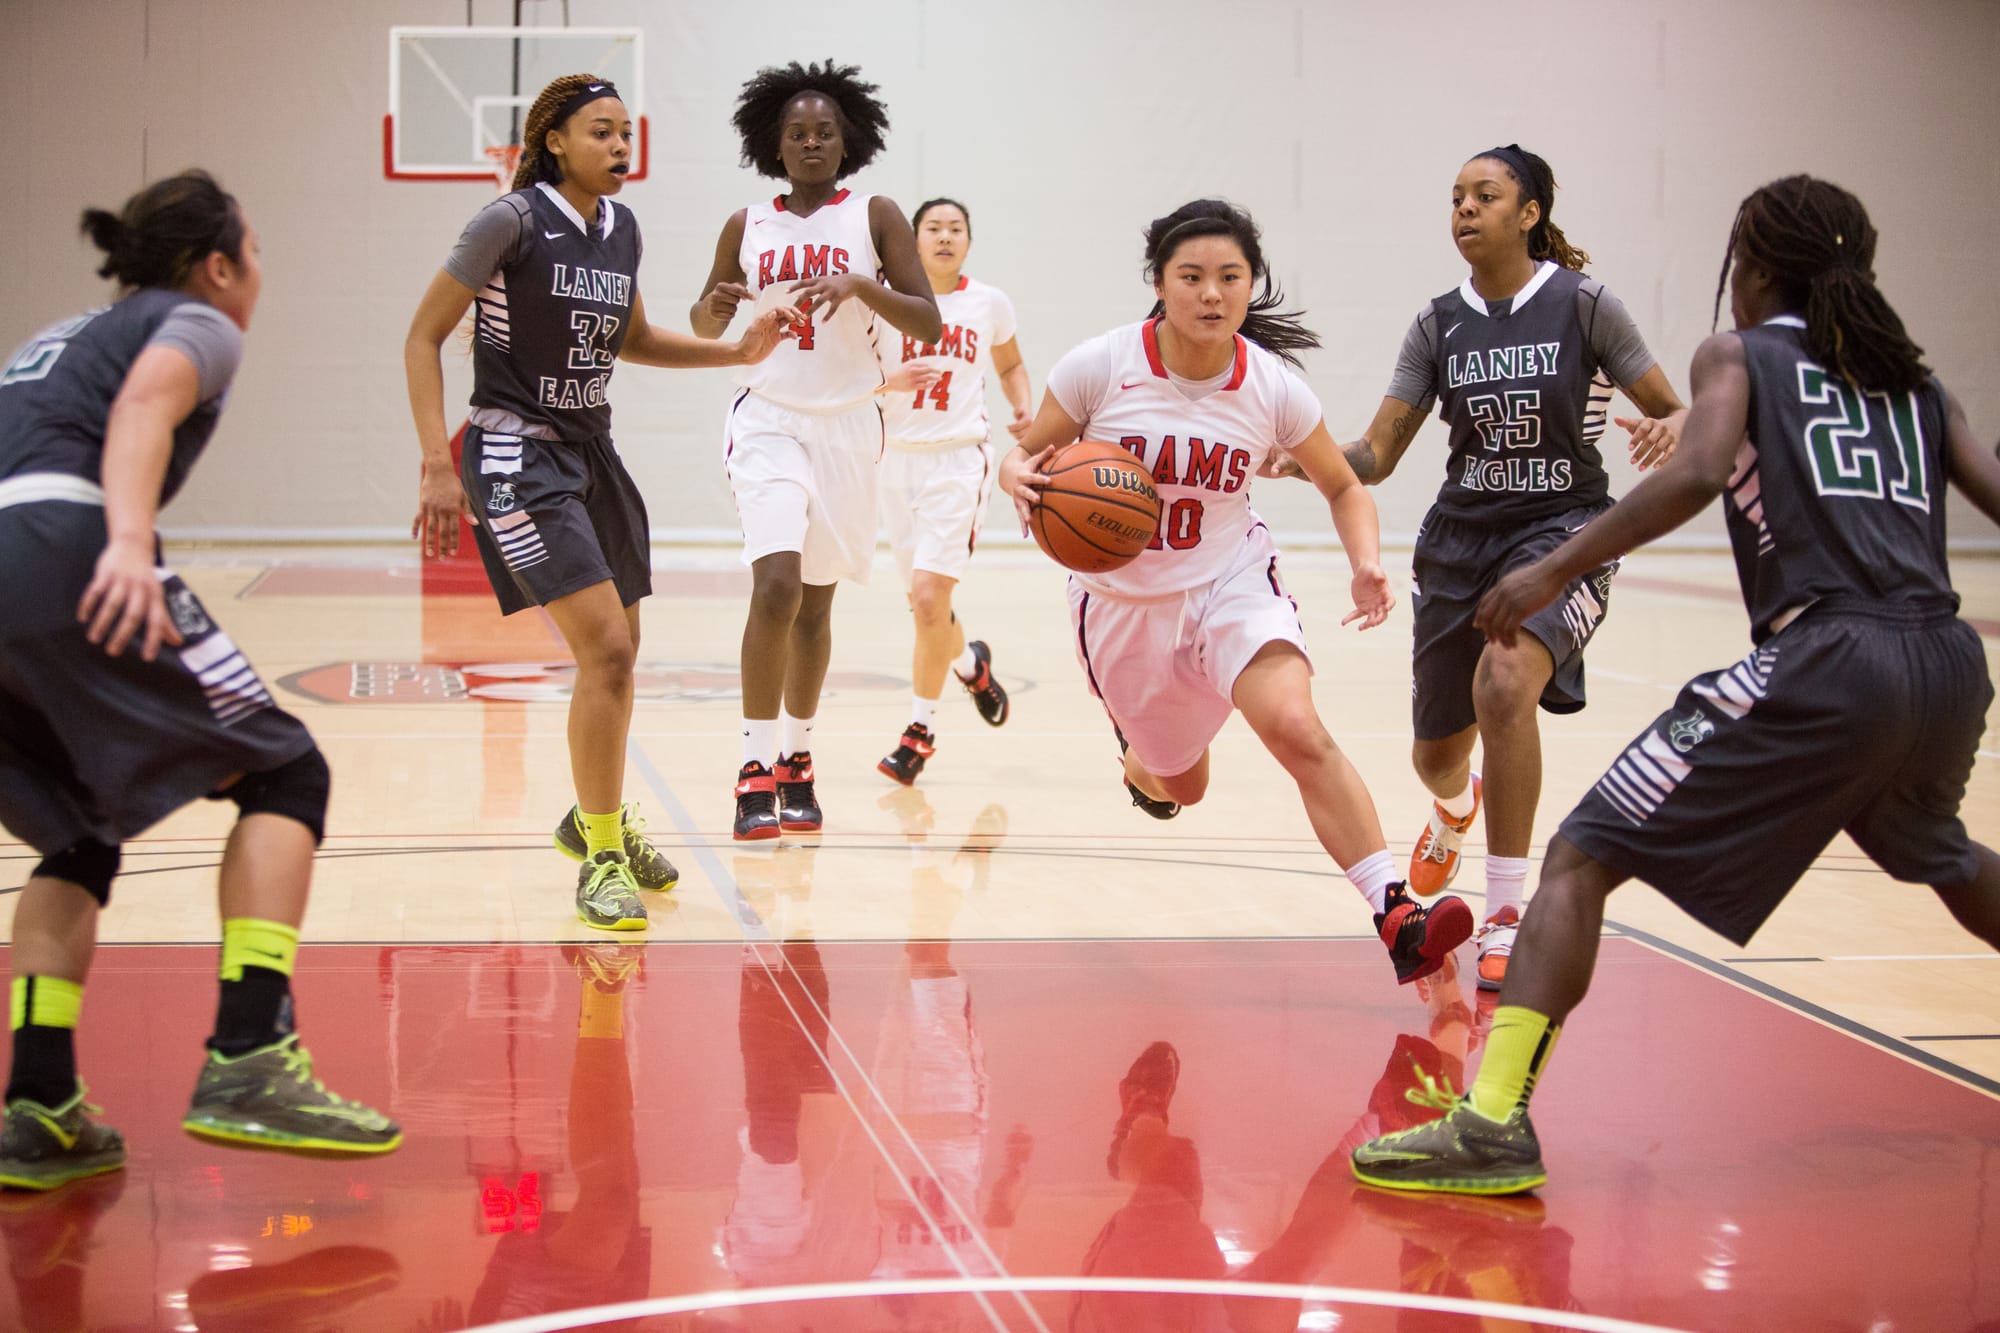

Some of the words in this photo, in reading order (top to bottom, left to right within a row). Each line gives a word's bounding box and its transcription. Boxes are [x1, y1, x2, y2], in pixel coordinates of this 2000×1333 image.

[551, 264, 632, 307] LANEY
[758, 244, 849, 291] RAMS
[1448, 342, 1560, 389] LANEY
[1467, 390, 1541, 452] 25
[1796, 361, 1930, 515] 21
[1087, 511, 1152, 540] EVOLUTI
